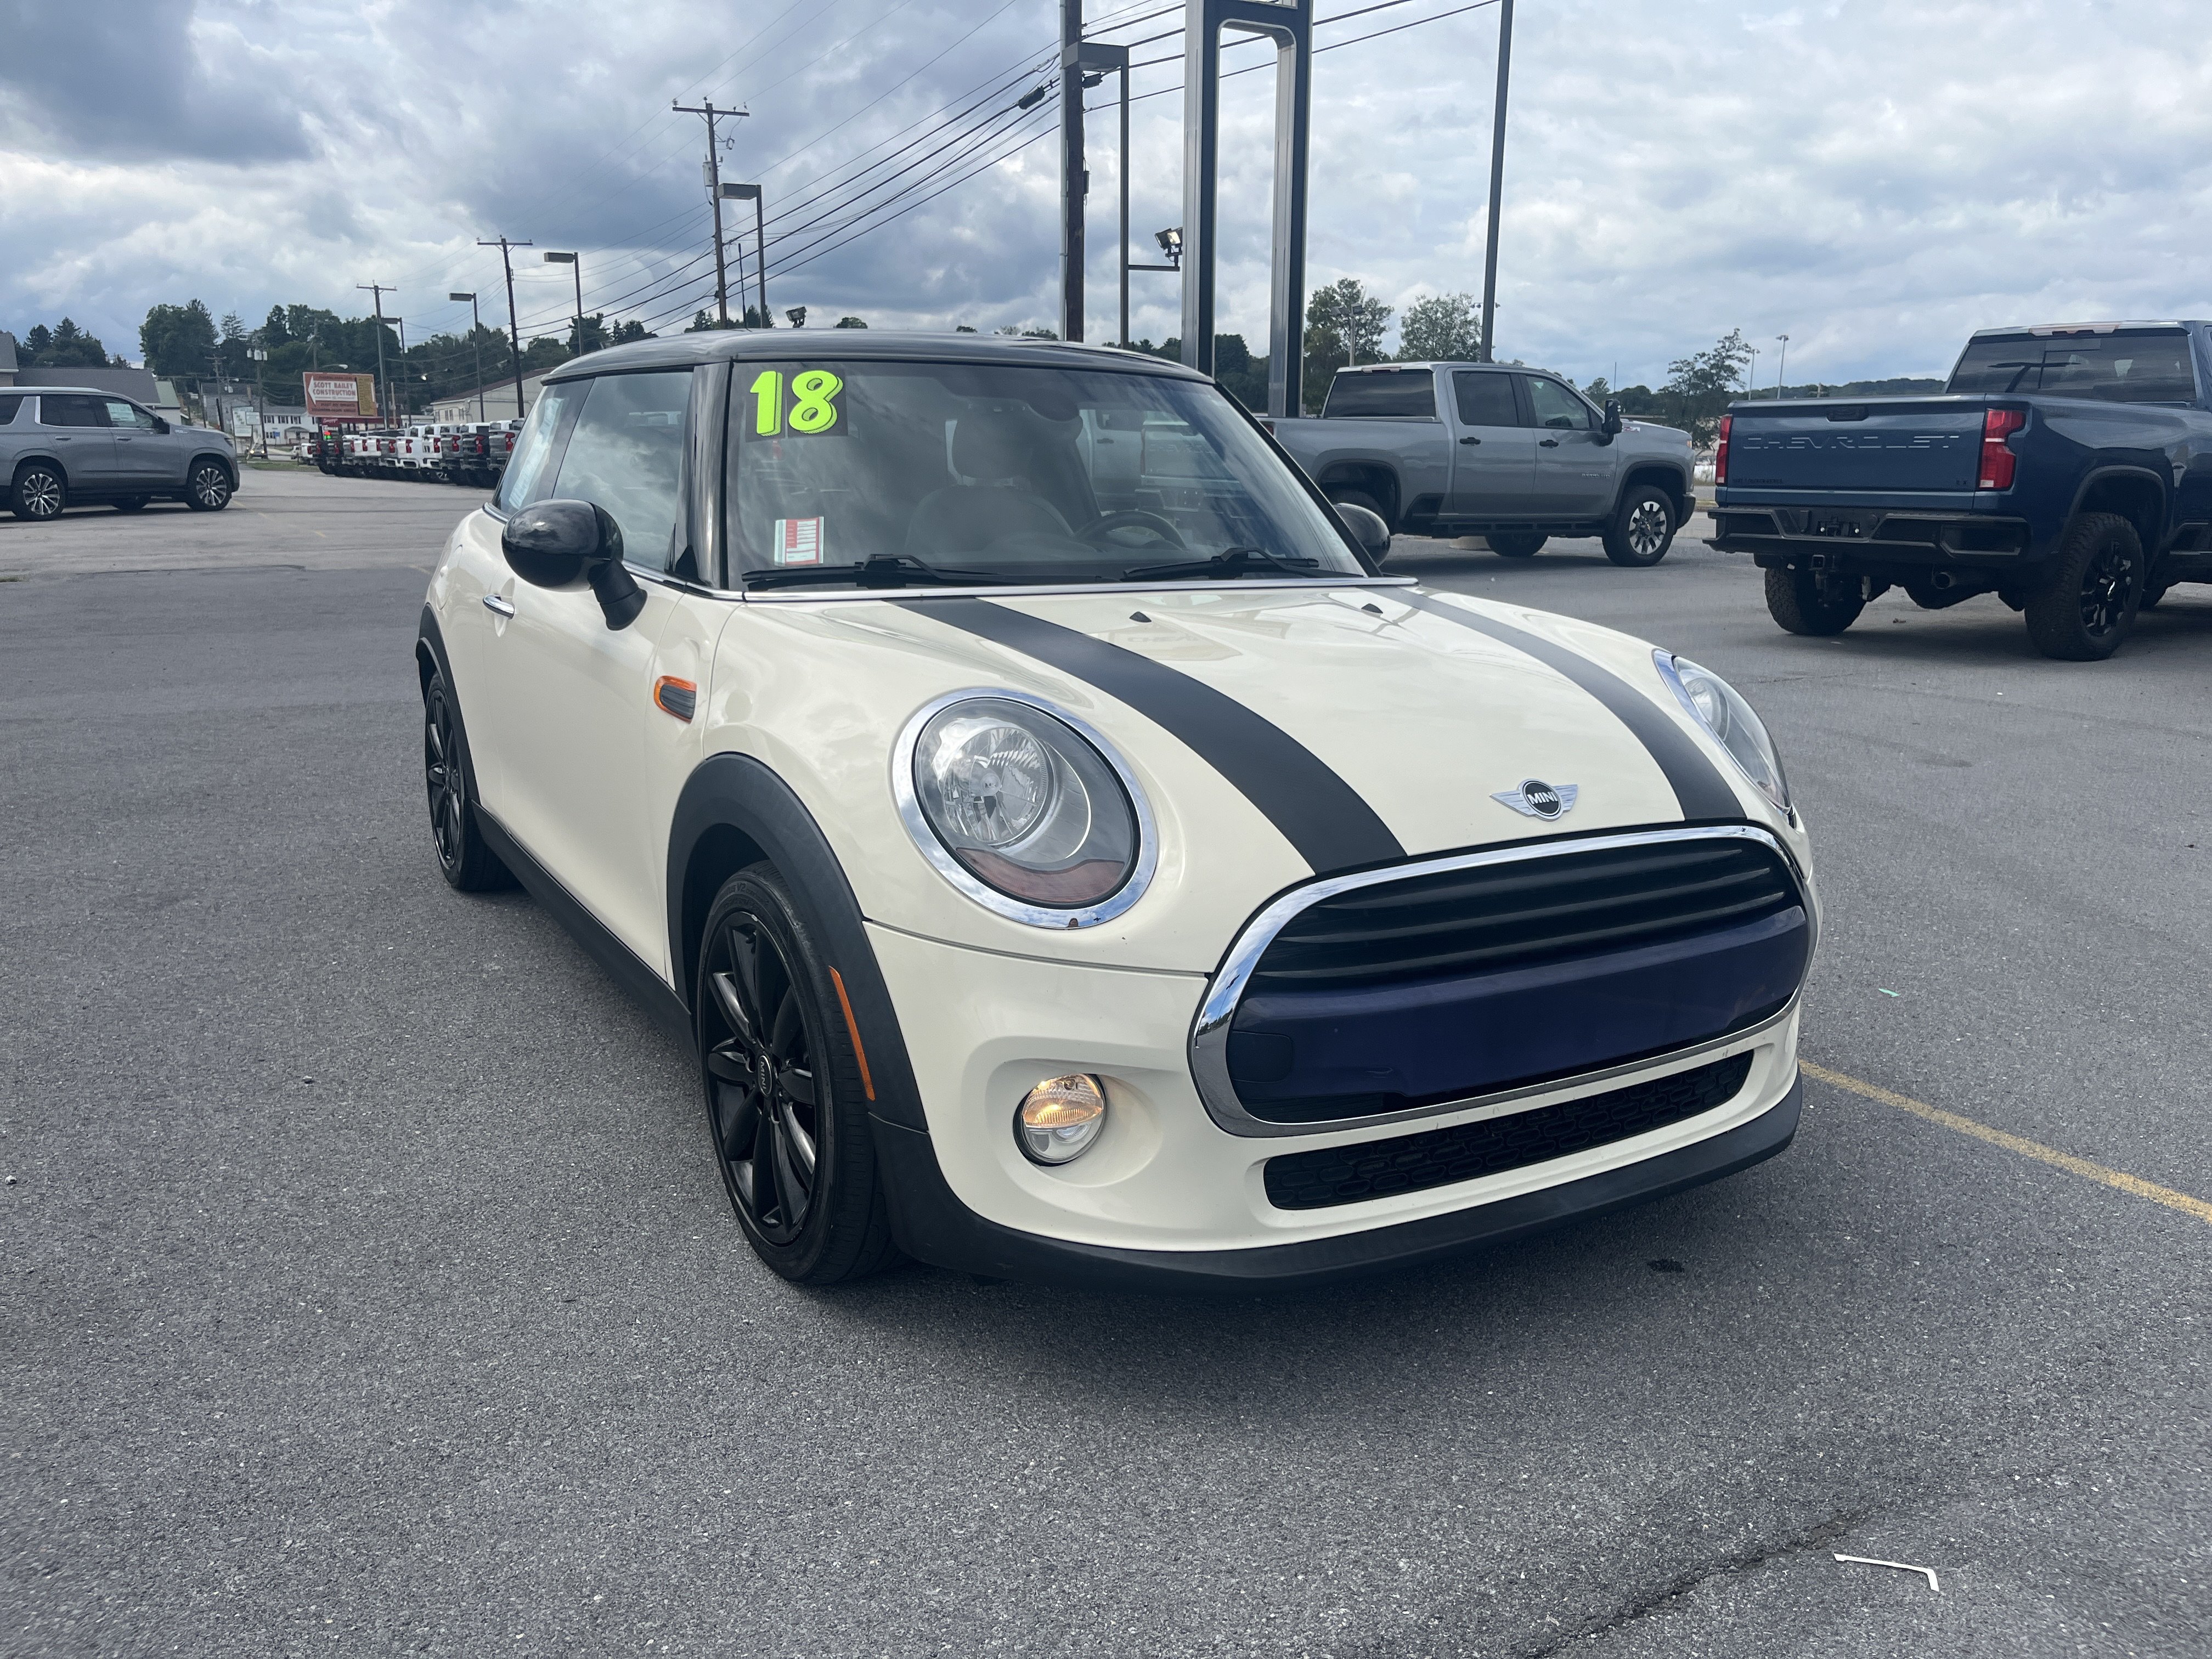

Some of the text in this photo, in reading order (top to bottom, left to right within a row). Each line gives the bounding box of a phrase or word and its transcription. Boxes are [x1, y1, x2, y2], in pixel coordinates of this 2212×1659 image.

[750, 370, 844, 437] 18
[1743, 435, 1959, 450] CHEVROLET
[1527, 791, 1558, 805] MINI
